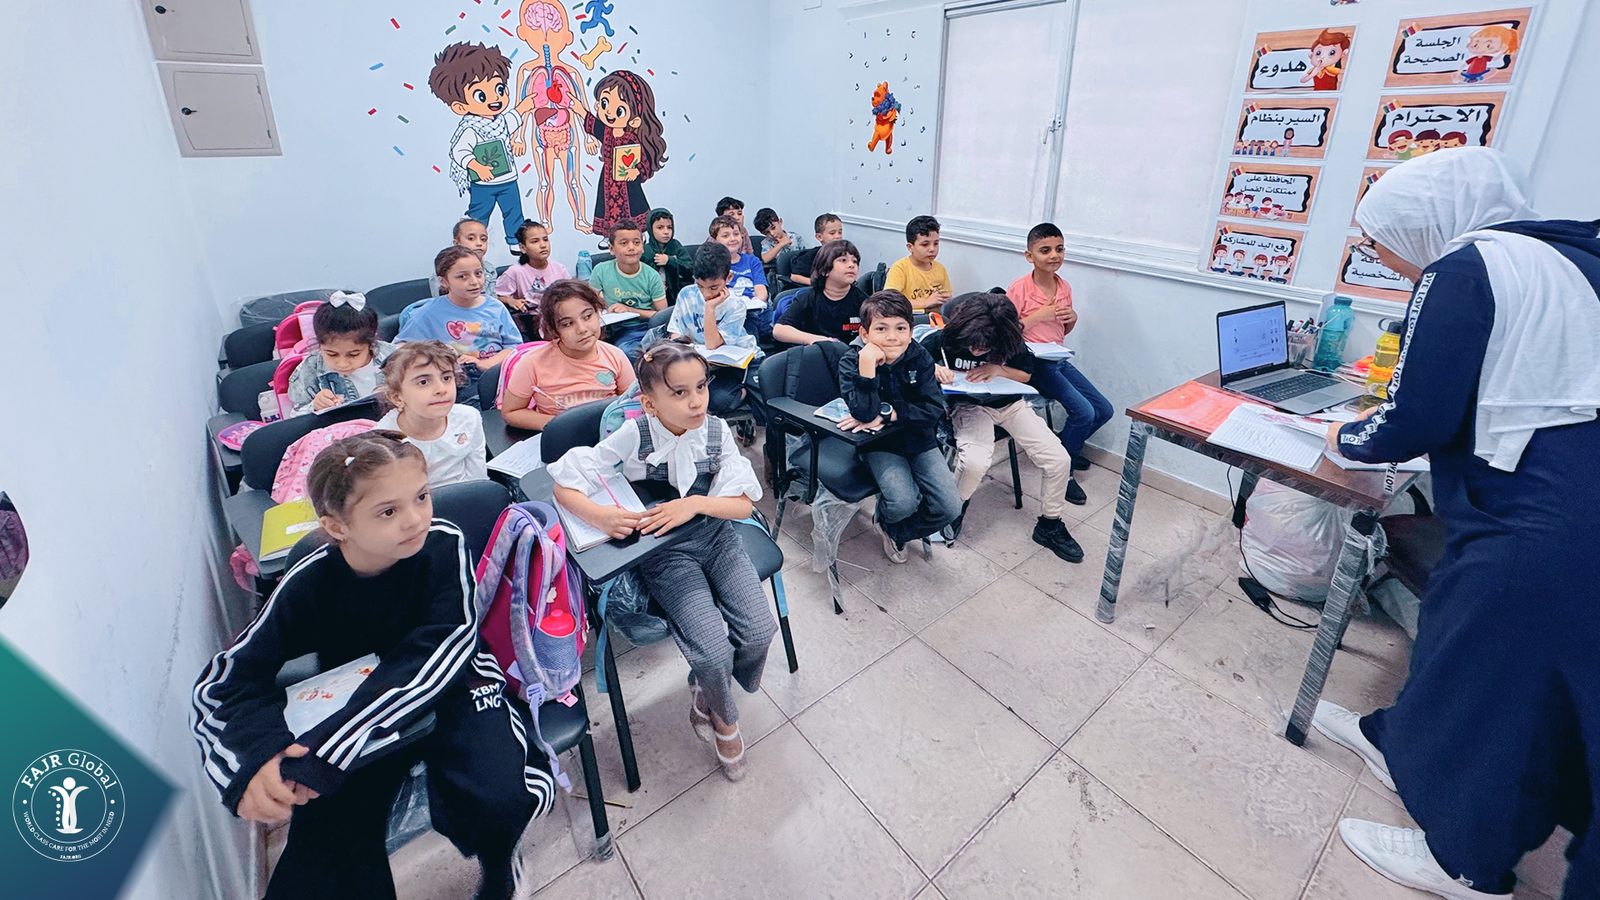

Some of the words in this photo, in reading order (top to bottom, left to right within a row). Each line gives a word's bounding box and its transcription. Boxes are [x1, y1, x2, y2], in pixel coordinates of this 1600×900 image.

[1416, 37, 1461, 49] الجلسة
[1404, 53, 1465, 66] الصحيحة
[1259, 60, 1307, 77] هدوء
[1251, 113, 1285, 126] بنظام
[1284, 113, 1320, 125] السير
[1223, 235, 1257, 247] للمشاركة
[1257, 242, 1274, 251] اليد
[1273, 243, 1289, 253] رفع
[1411, 292, 1426, 315] LOVE
[955, 357, 978, 370] ONE
[469, 682, 500, 700] XBM
